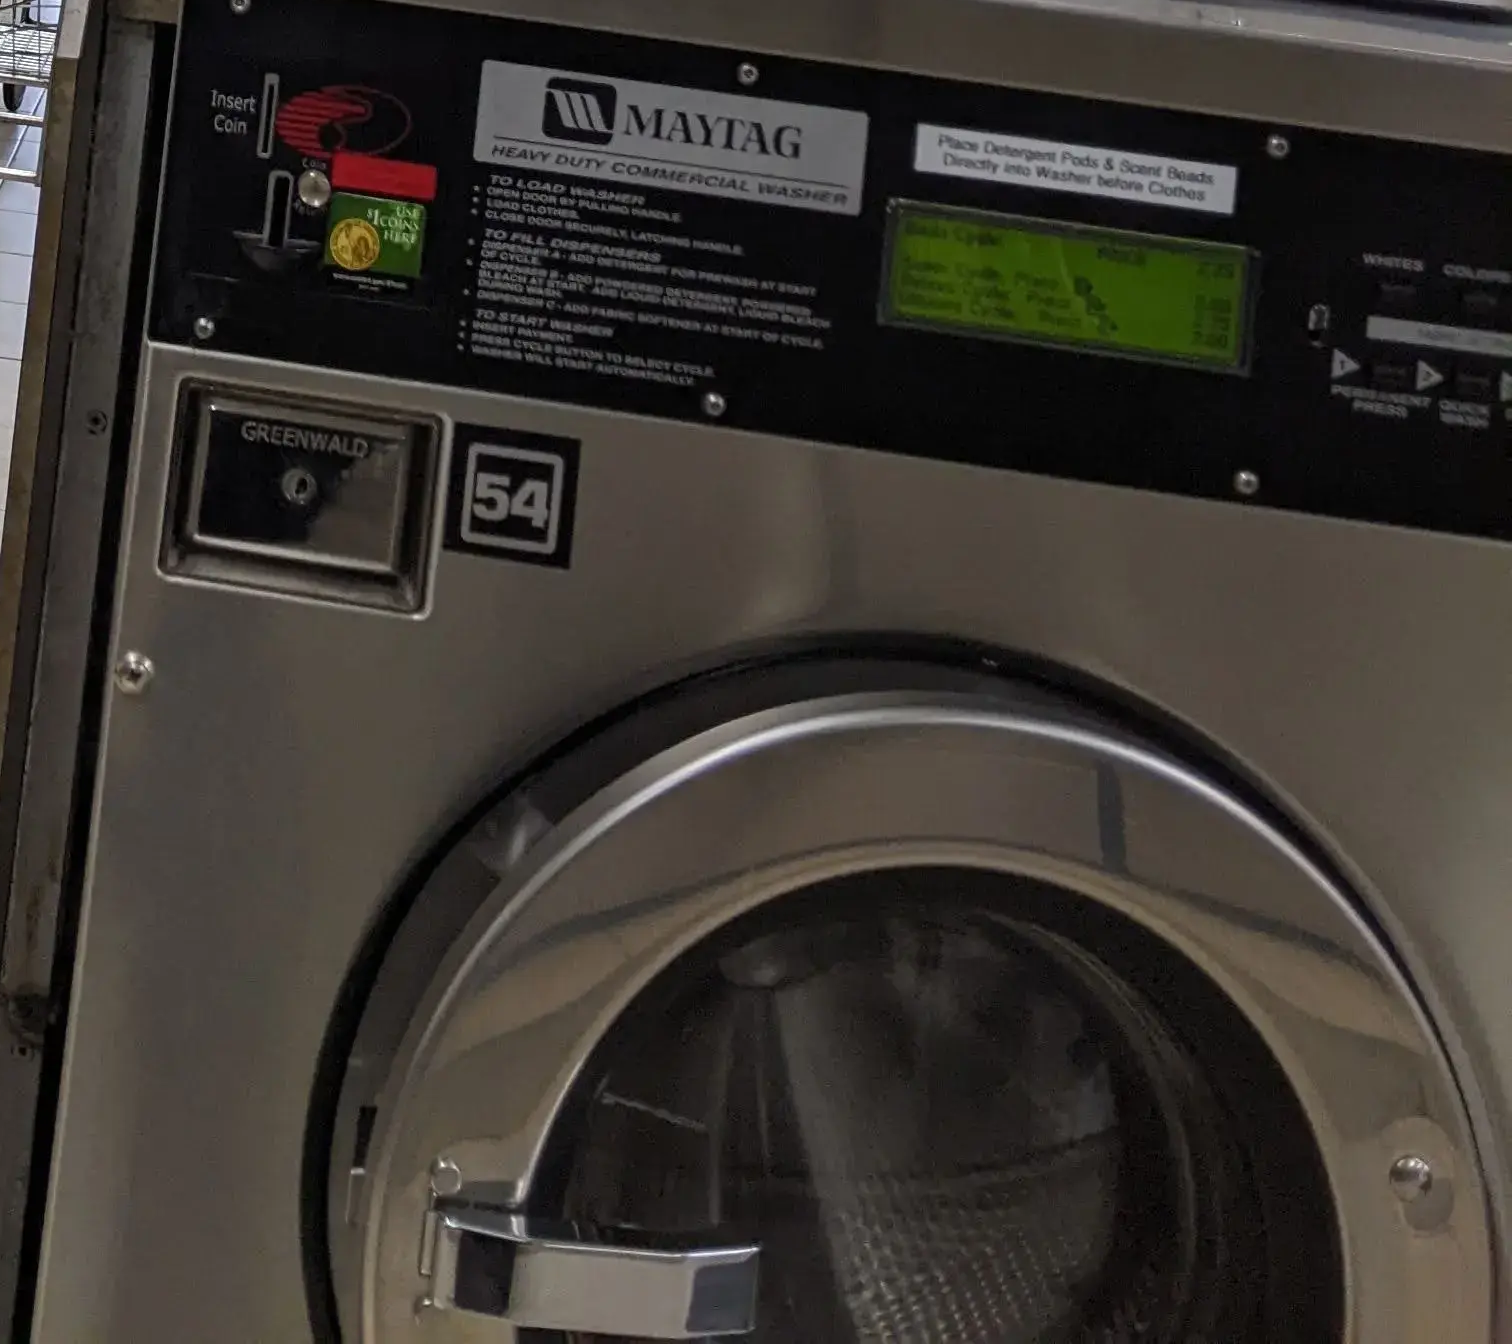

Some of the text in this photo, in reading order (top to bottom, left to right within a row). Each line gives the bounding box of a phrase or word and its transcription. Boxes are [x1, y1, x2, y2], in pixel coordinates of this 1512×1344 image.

[210, 90, 256, 112] Insert
[214, 114, 248, 135] Coin
[624, 104, 803, 160] MAYTAG
[938, 134, 1215, 185] Place Detergent Pods & Scent Beads
[492, 145, 849, 207] HEAVY DUTY COMMERCIAL WASHER
[943, 153, 1206, 202] Directly into Washer before Clothes
[486, 185, 519, 199] OPEN
[522, 190, 556, 204] DOOR
[490, 174, 645, 206] TO LOAD WASHER
[486, 198, 519, 211] LOAD
[384, 230, 418, 246] HERE
[484, 209, 525, 224] CLOSE
[527, 215, 562, 229] DOOR
[630, 229, 690, 247] LATCHING
[484, 228, 662, 263] TO FILL DISPENSERS
[568, 252, 594, 265] ADD
[1362, 252, 1425, 272] WHITES
[475, 308, 495, 321] TO
[497, 311, 547, 328] START
[1352, 399, 1410, 419] PRESS
[241, 420, 369, 459] GREENWALD
[472, 472, 550, 529] 54
